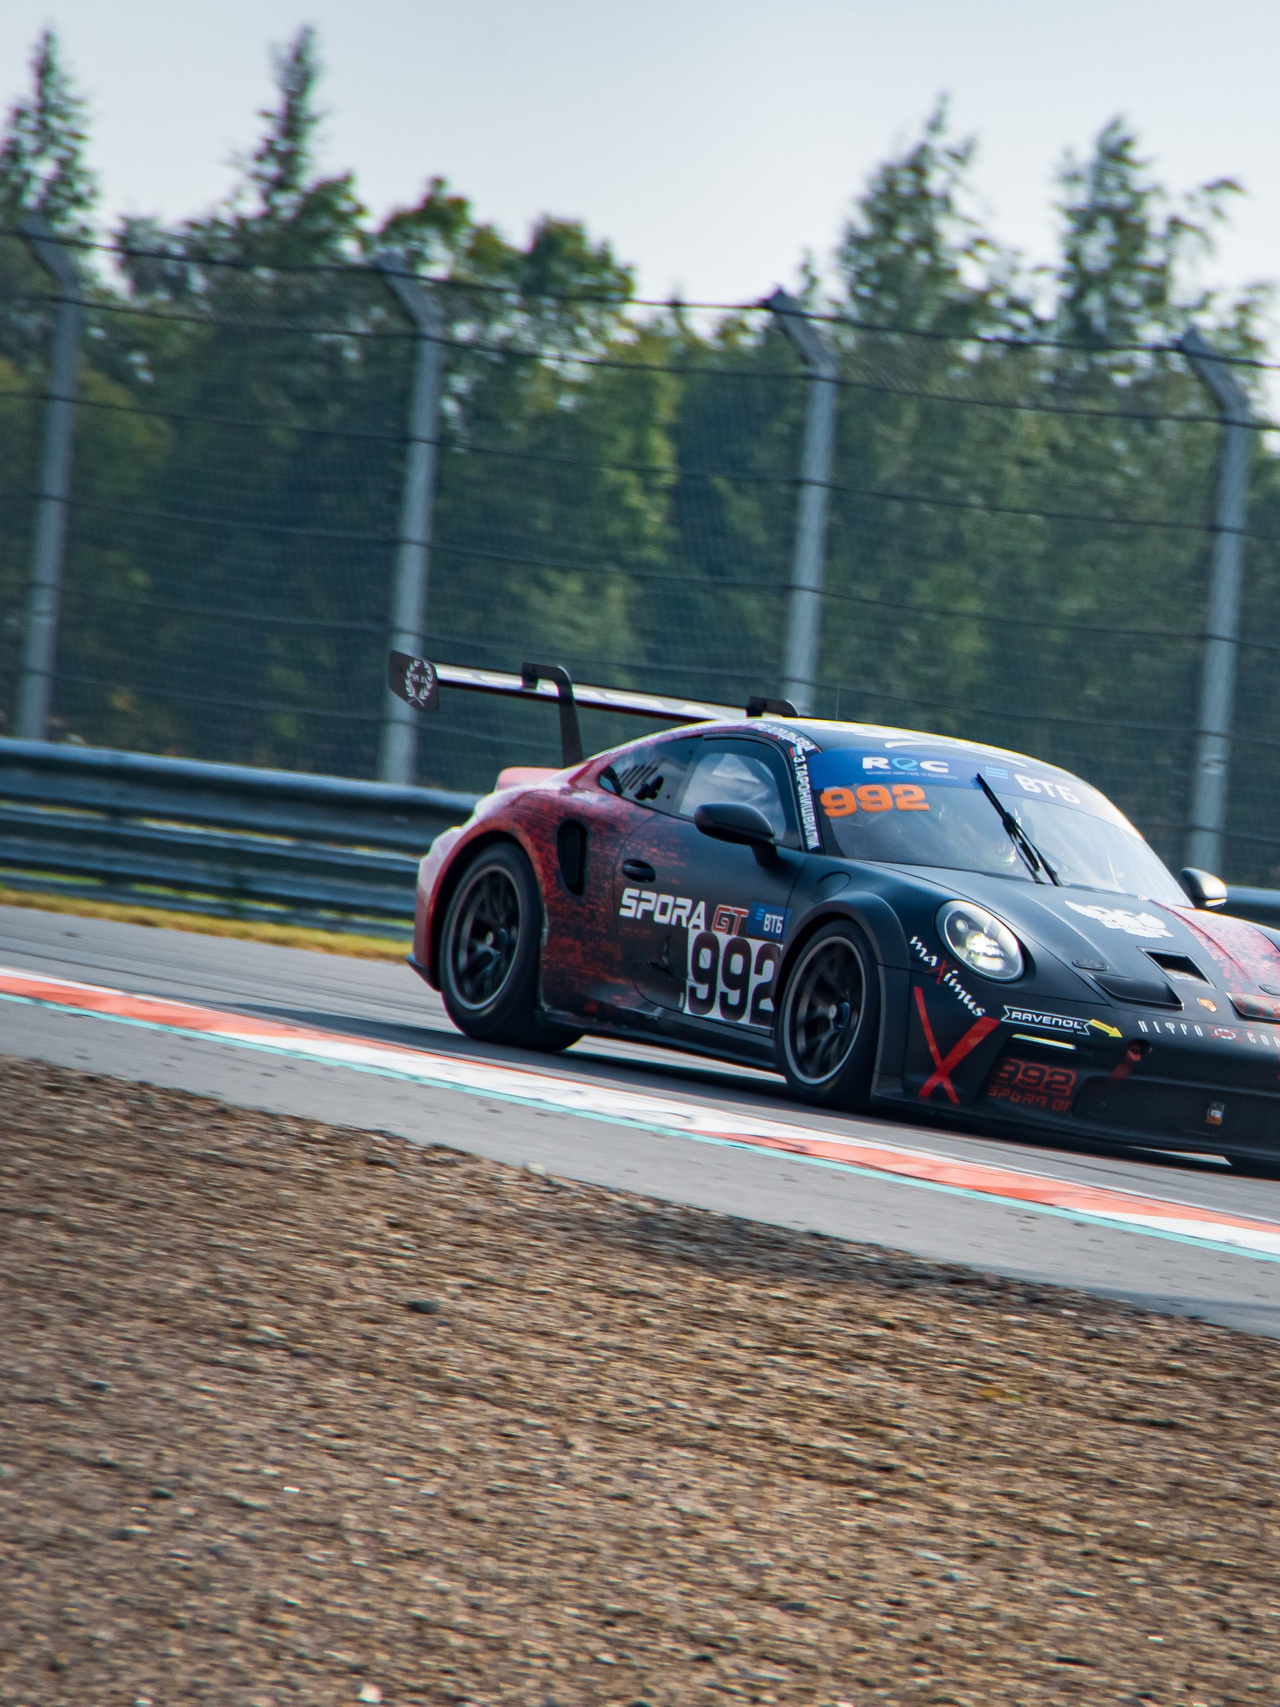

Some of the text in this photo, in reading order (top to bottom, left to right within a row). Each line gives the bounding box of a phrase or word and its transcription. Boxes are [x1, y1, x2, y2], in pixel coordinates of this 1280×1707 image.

[820, 784, 930, 818] 992
[1014, 774, 1080, 804] ВТБ
[619, 887, 749, 937] SPORA GT
[763, 913, 784, 934] ВТБ
[687, 930, 782, 1028] 992
[1011, 1009, 1084, 1030] RAVENOL
